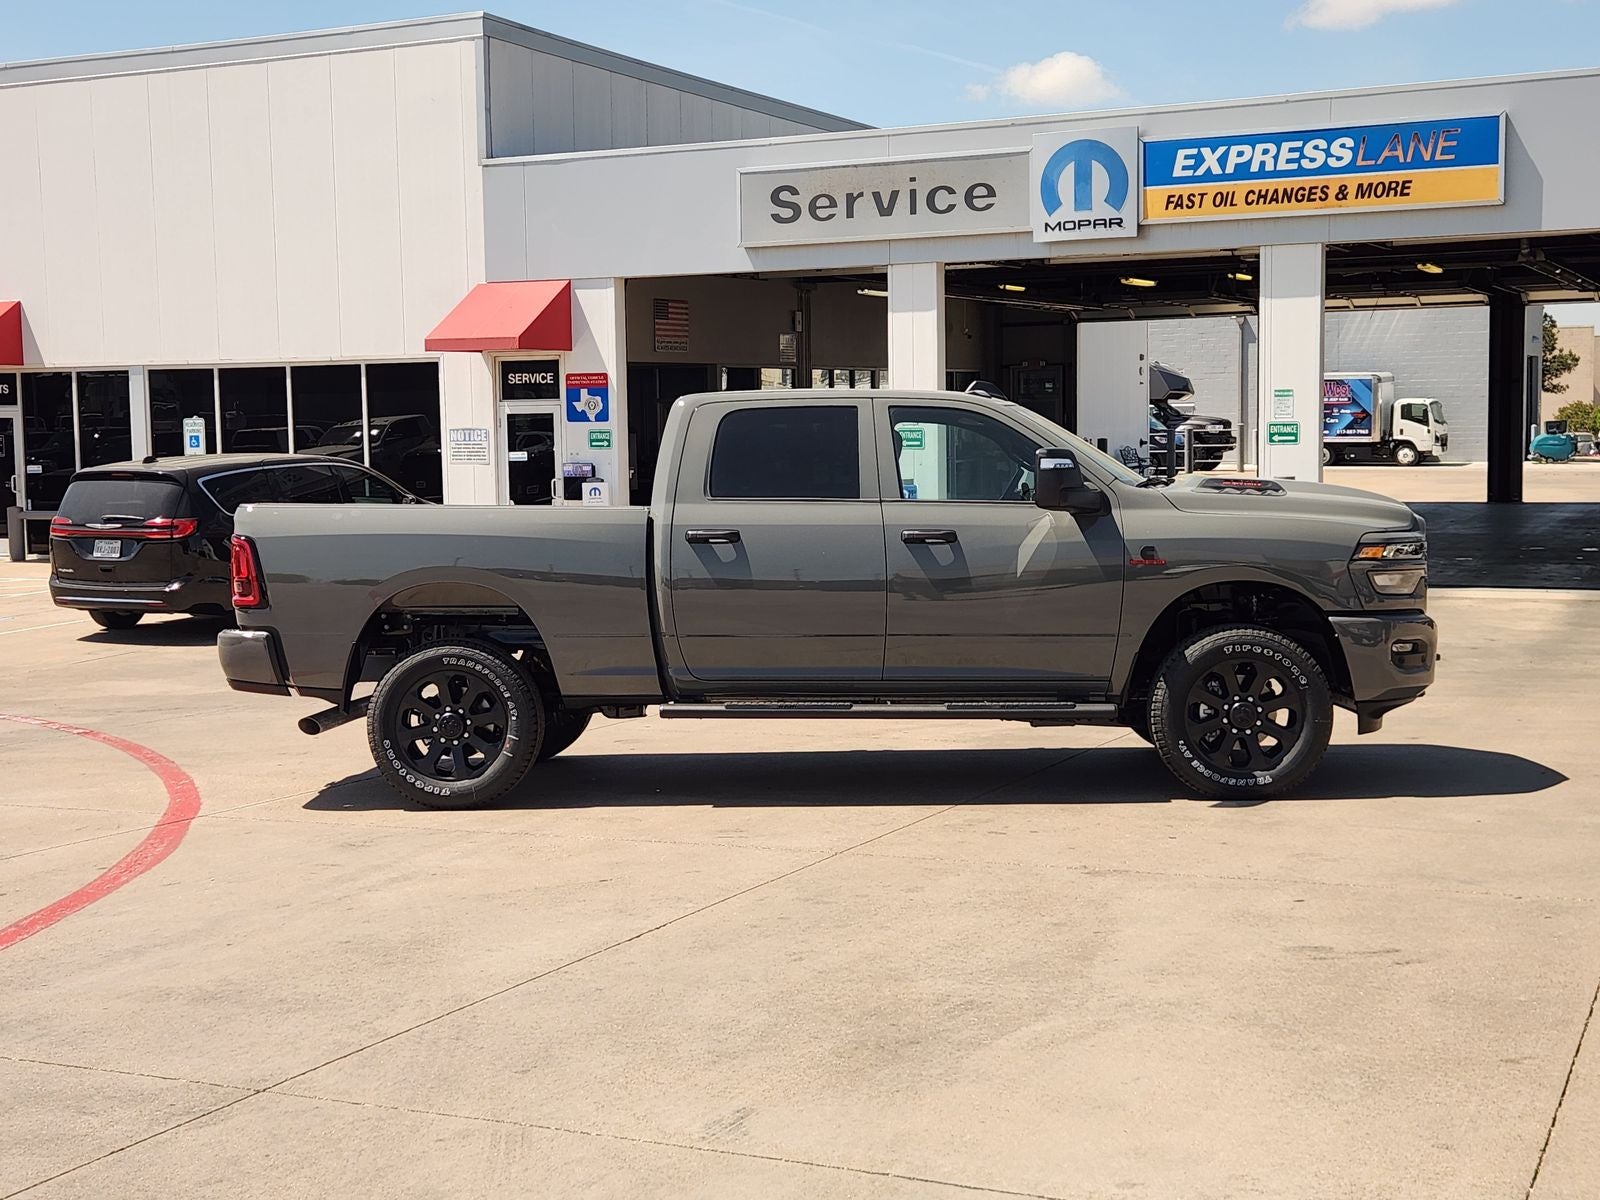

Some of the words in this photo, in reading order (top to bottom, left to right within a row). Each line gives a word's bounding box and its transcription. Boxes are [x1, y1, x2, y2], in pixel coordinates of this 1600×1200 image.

[769, 176, 997, 224] Service
[1164, 192, 1208, 211] FAST
[1212, 190, 1238, 208] OIL
[1244, 184, 1330, 206] CHANGES
[1335, 185, 1349, 201] &
[1355, 179, 1413, 199] MORE
[1044, 216, 1124, 233] MOPAR
[507, 372, 554, 385] SERVICE
[1324, 381, 1351, 397] West
[450, 429, 488, 441] NOTICE
[591, 432, 610, 440] ENTRANCE
[900, 431, 922, 439] NTRANCE
[1270, 425, 1297, 433] ENTRANCE
[441, 656, 511, 698] TRANSFORCE
[1190, 759, 1273, 786] TRANSFORCE
